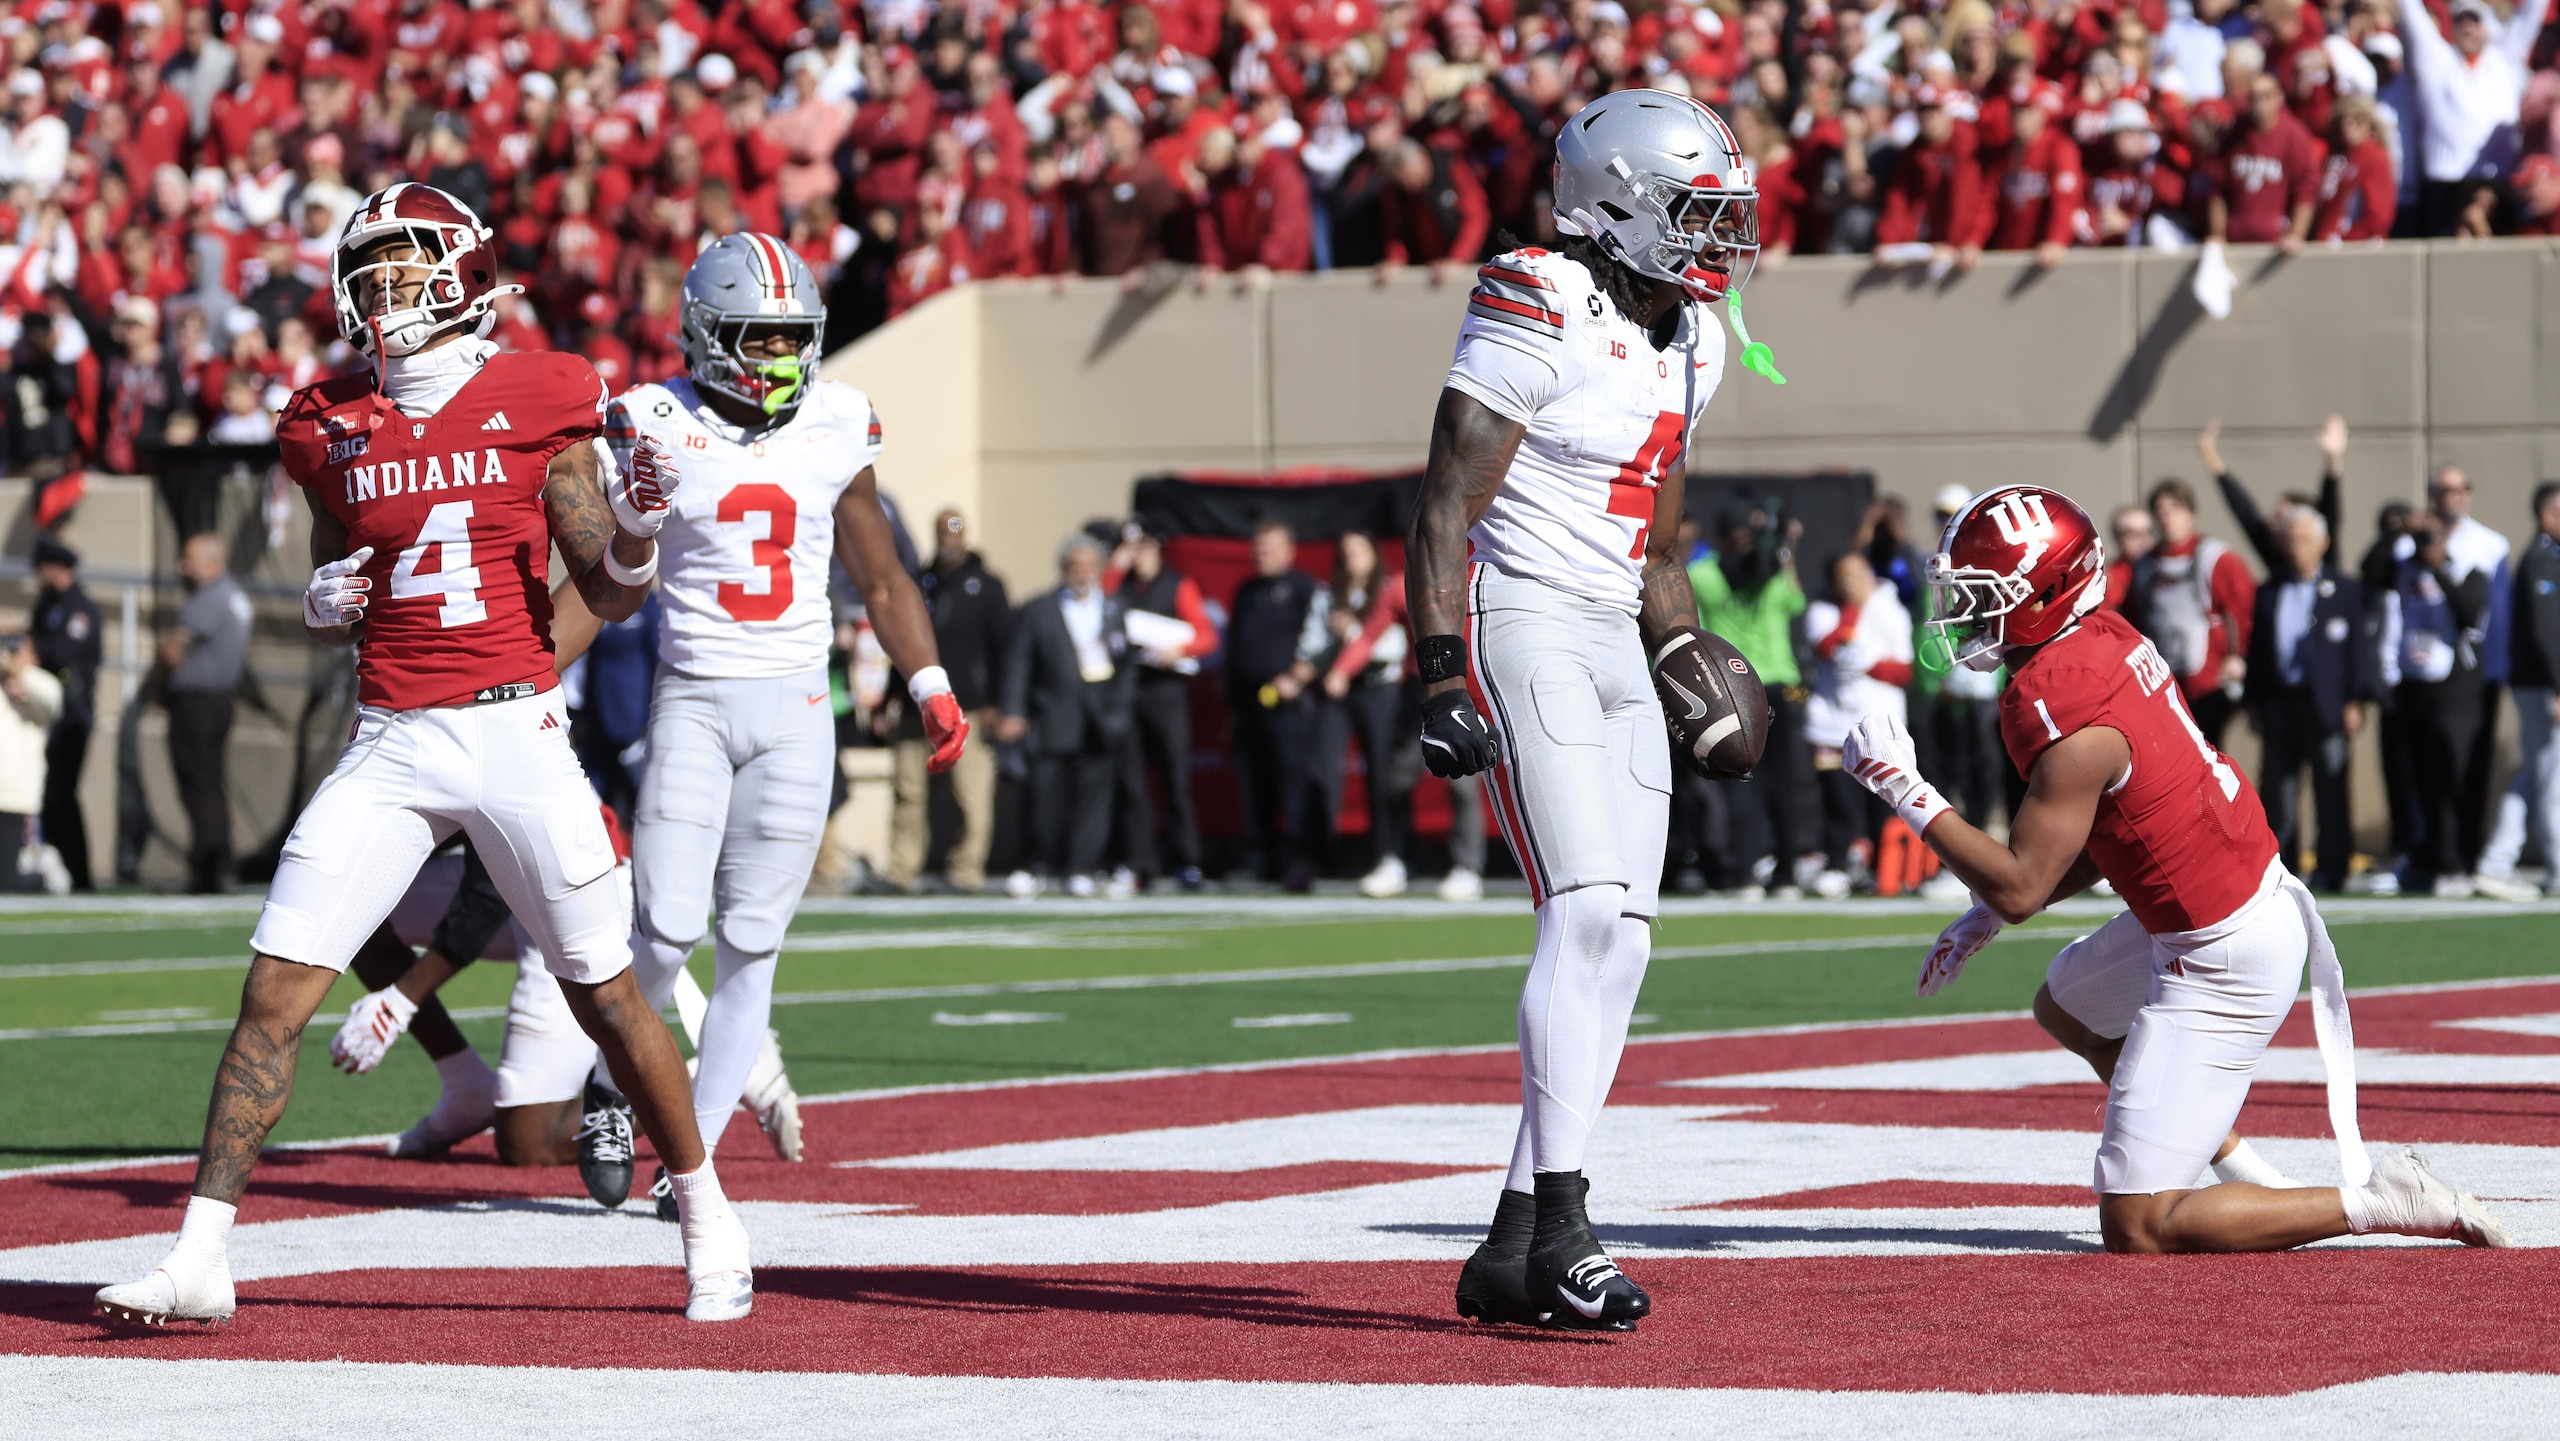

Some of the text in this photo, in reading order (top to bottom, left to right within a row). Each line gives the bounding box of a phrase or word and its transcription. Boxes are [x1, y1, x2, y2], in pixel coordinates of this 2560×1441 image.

[1584, 317, 1608, 328] CHASE
[316, 420, 356, 437] MERCHANTS
[596, 377, 610, 426] 4
[343, 448, 508, 504] INDIANA
[1605, 410, 1687, 561] 4
[390, 500, 488, 629] 4
[716, 483, 797, 623] 3
[2034, 698, 2062, 741] 1
[2164, 680, 2241, 804] 1
